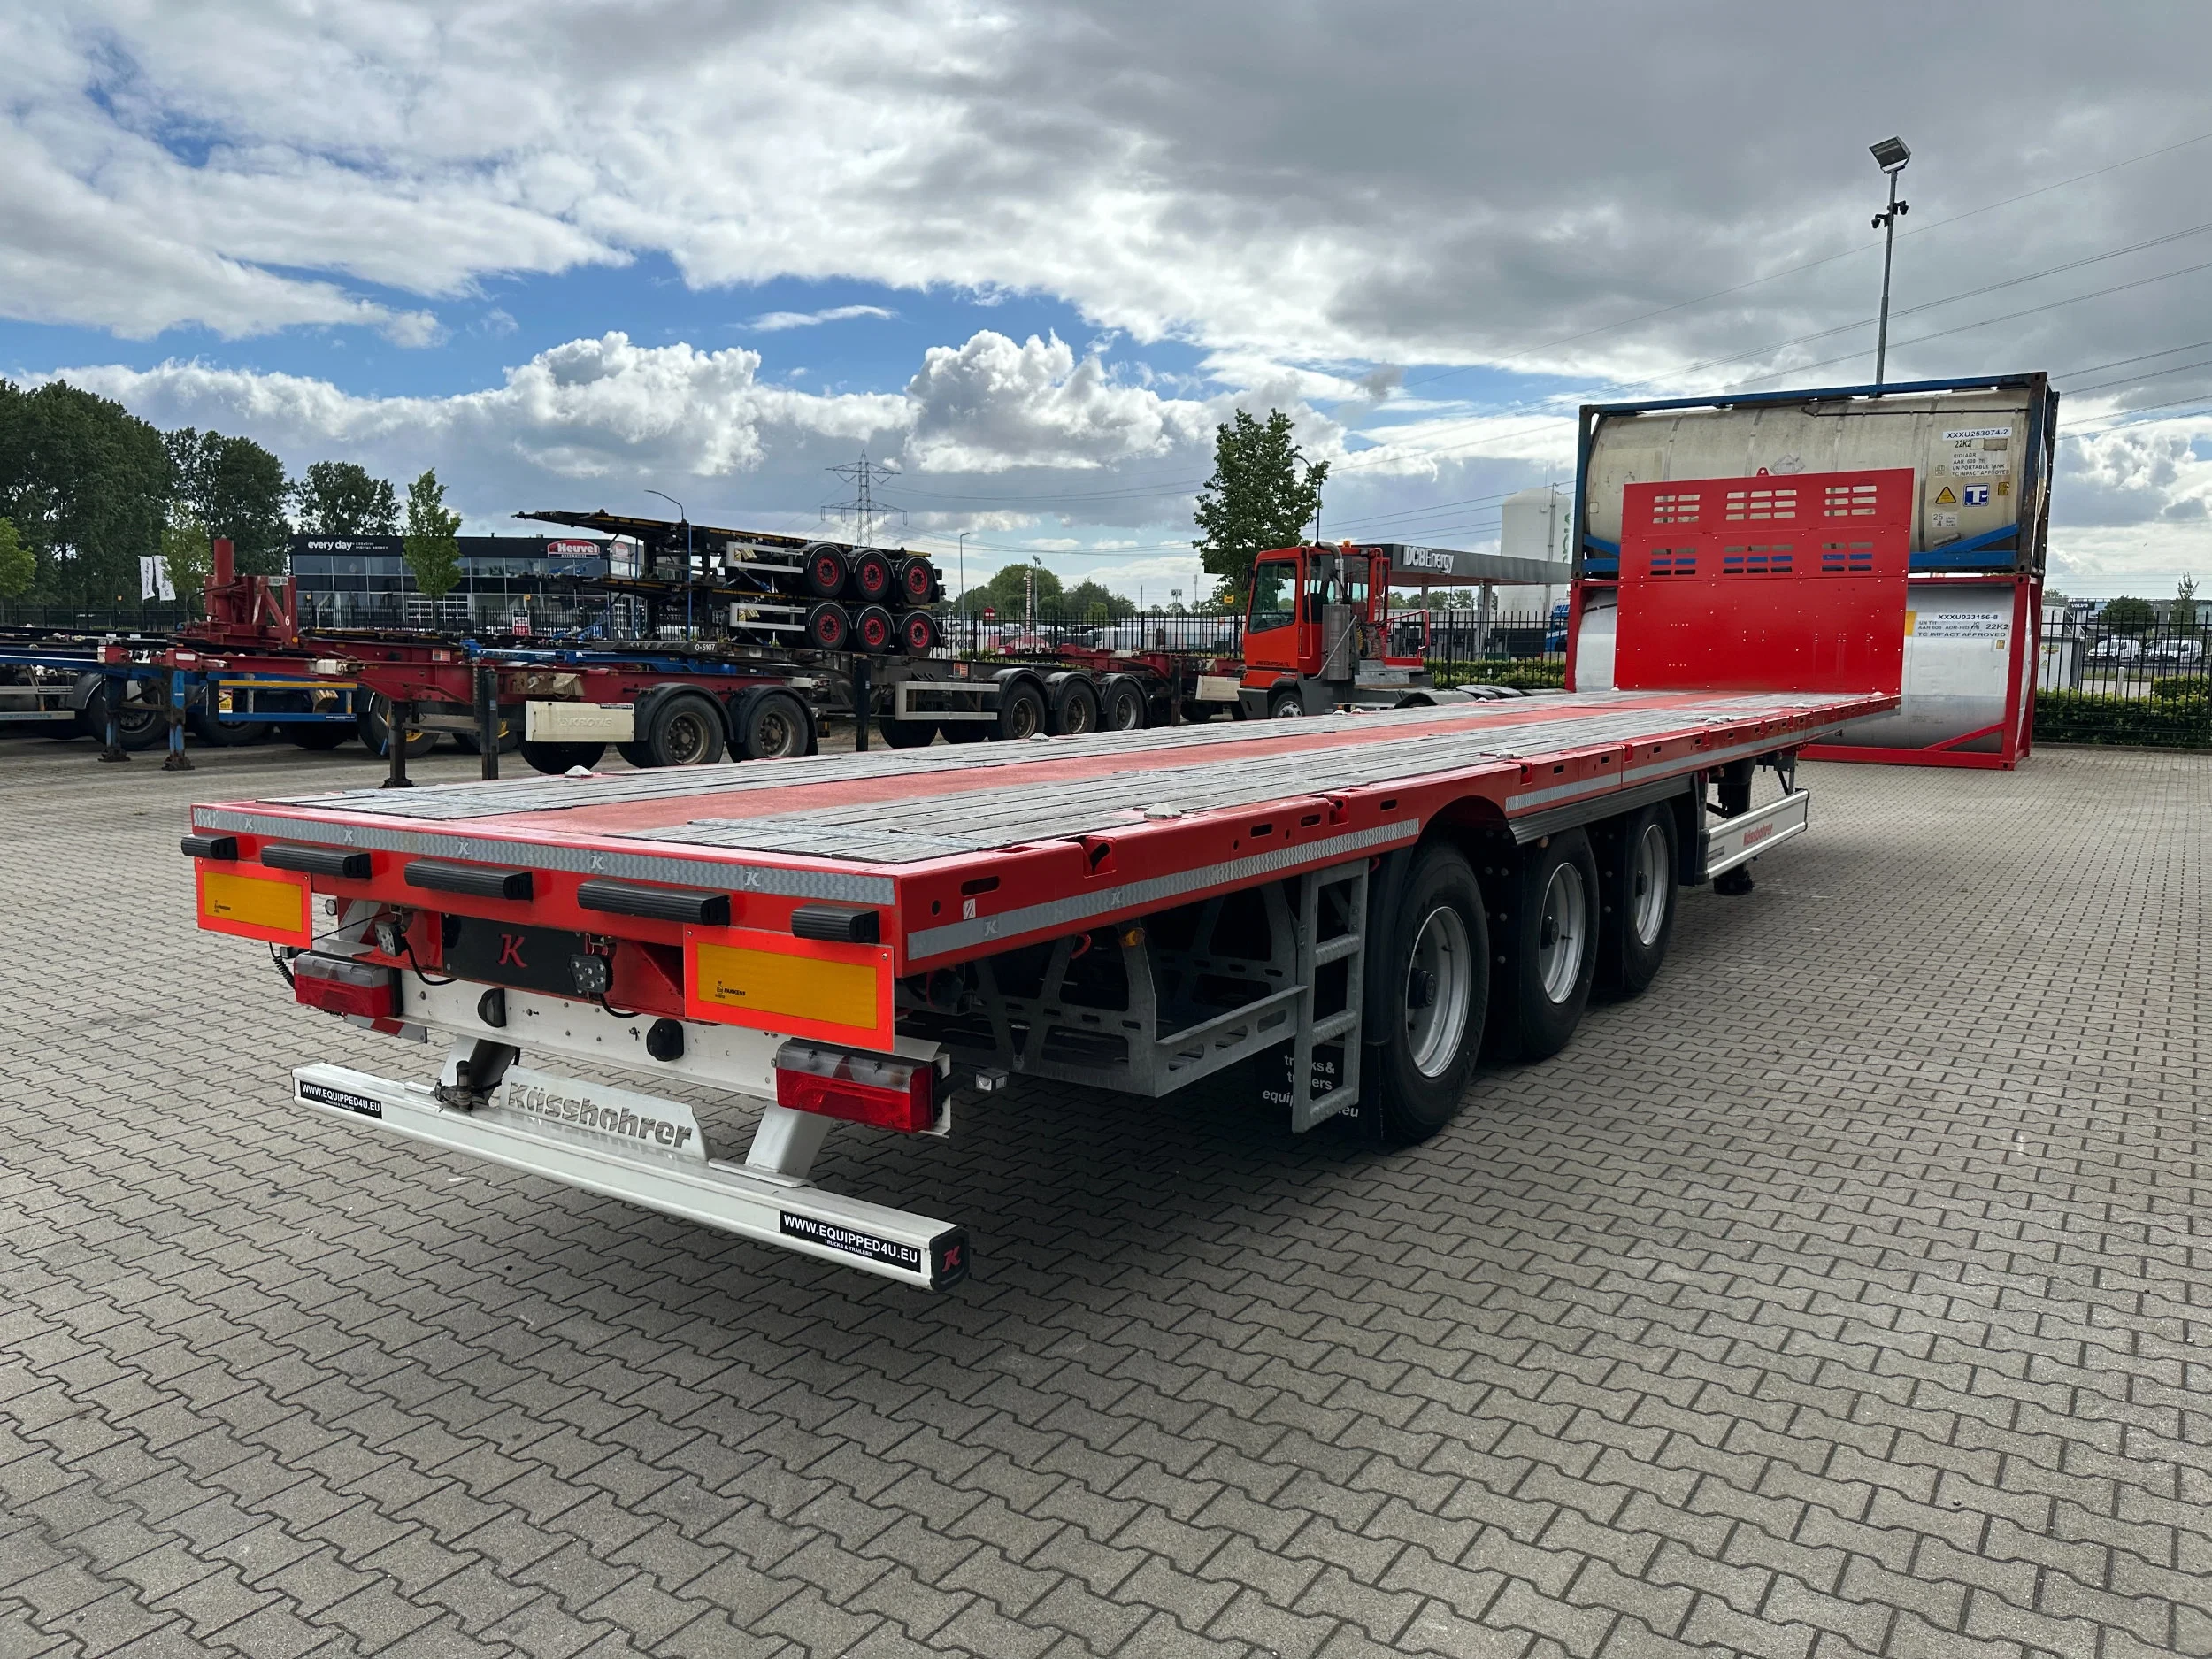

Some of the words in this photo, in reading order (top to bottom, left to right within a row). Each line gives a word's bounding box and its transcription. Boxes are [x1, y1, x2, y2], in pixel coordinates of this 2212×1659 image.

[1947, 429, 2008, 439] XXXU253074-2
[308, 541, 334, 550] every
[335, 540, 352, 550] day
[557, 543, 598, 553] Heuvel
[285, 615, 290, 626] 6
[498, 934, 528, 968] K
[1285, 1054, 1325, 1072] trks
[1325, 1062, 1335, 1074] &
[1287, 1071, 1333, 1090] ters
[302, 1083, 380, 1112] WWW.EQUIPPED4U.EU
[783, 1214, 918, 1263] WWW.EQUIPPED4U.EU
[824, 1239, 843, 1249] TRUCKS
[849, 1246, 873, 1257] TRAILERS
[941, 1246, 961, 1272] K
